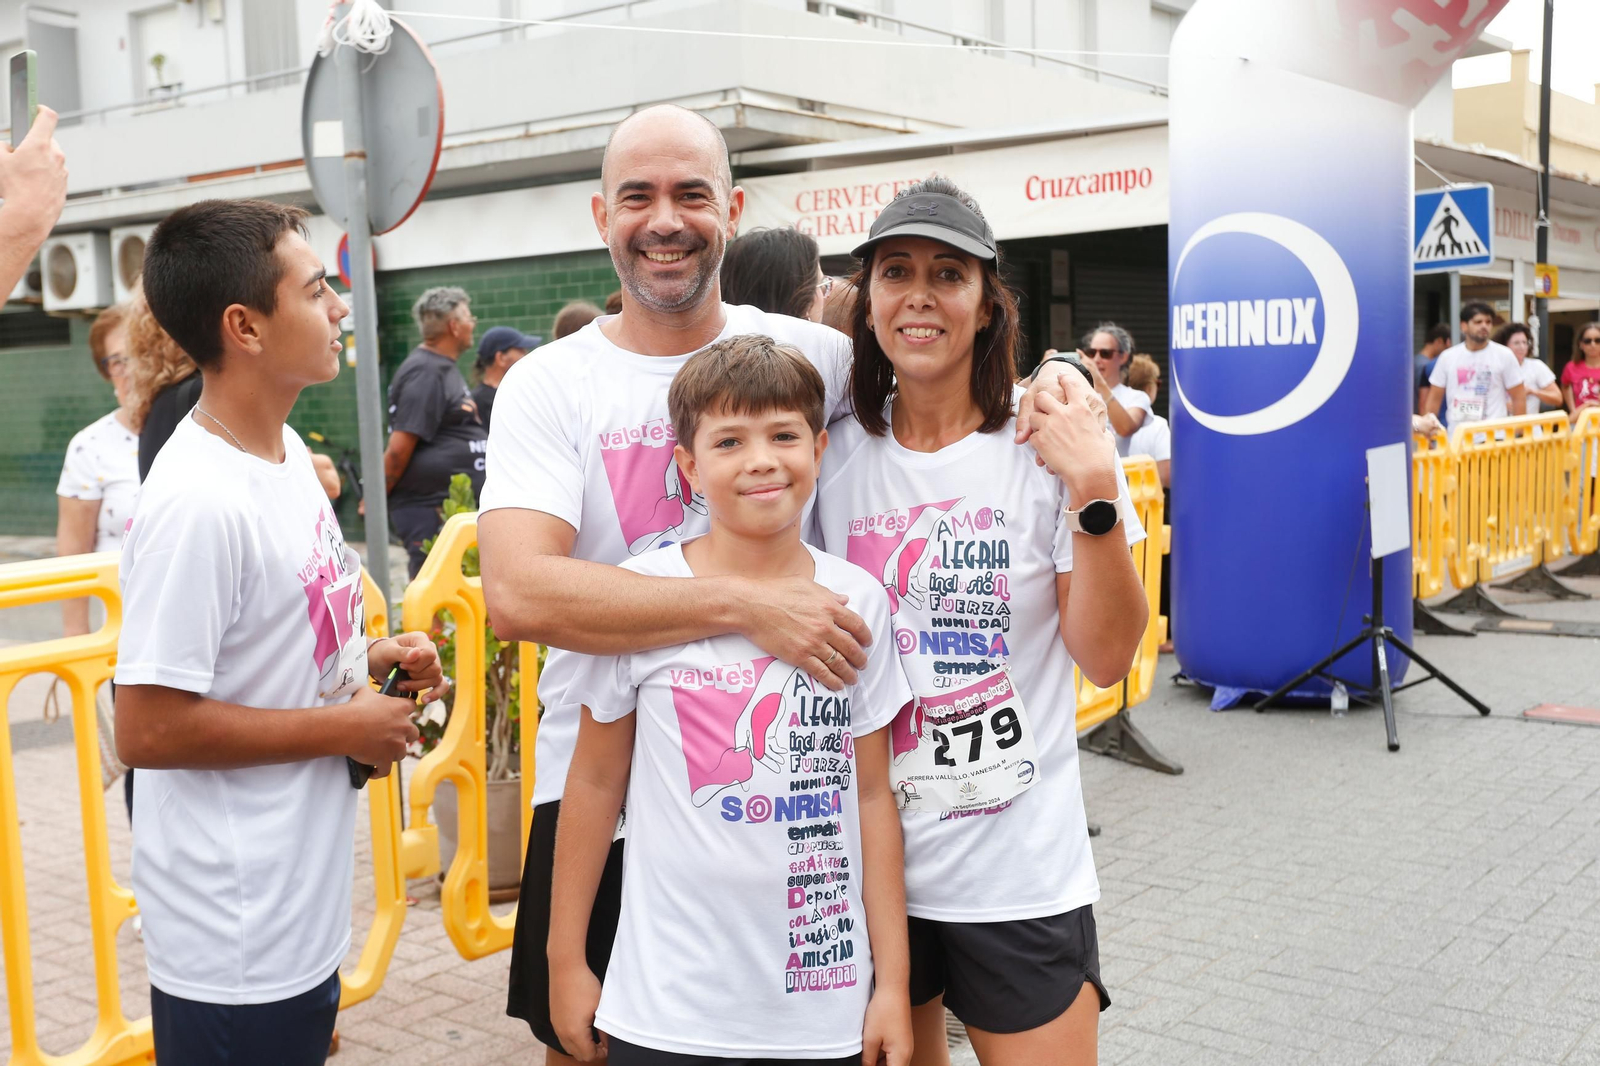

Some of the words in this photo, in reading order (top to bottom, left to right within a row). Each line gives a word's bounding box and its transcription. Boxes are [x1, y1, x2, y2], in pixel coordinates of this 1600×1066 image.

[1025, 166, 1153, 201] Cruzcampo
[1172, 297, 1317, 350] ACERINOX
[929, 594, 1011, 616] FUERZA
[895, 628, 1010, 657] ONRISA
[932, 707, 1023, 767] 279
[790, 754, 851, 773] FUERZA
[970, 763, 1001, 777] VANESSA
